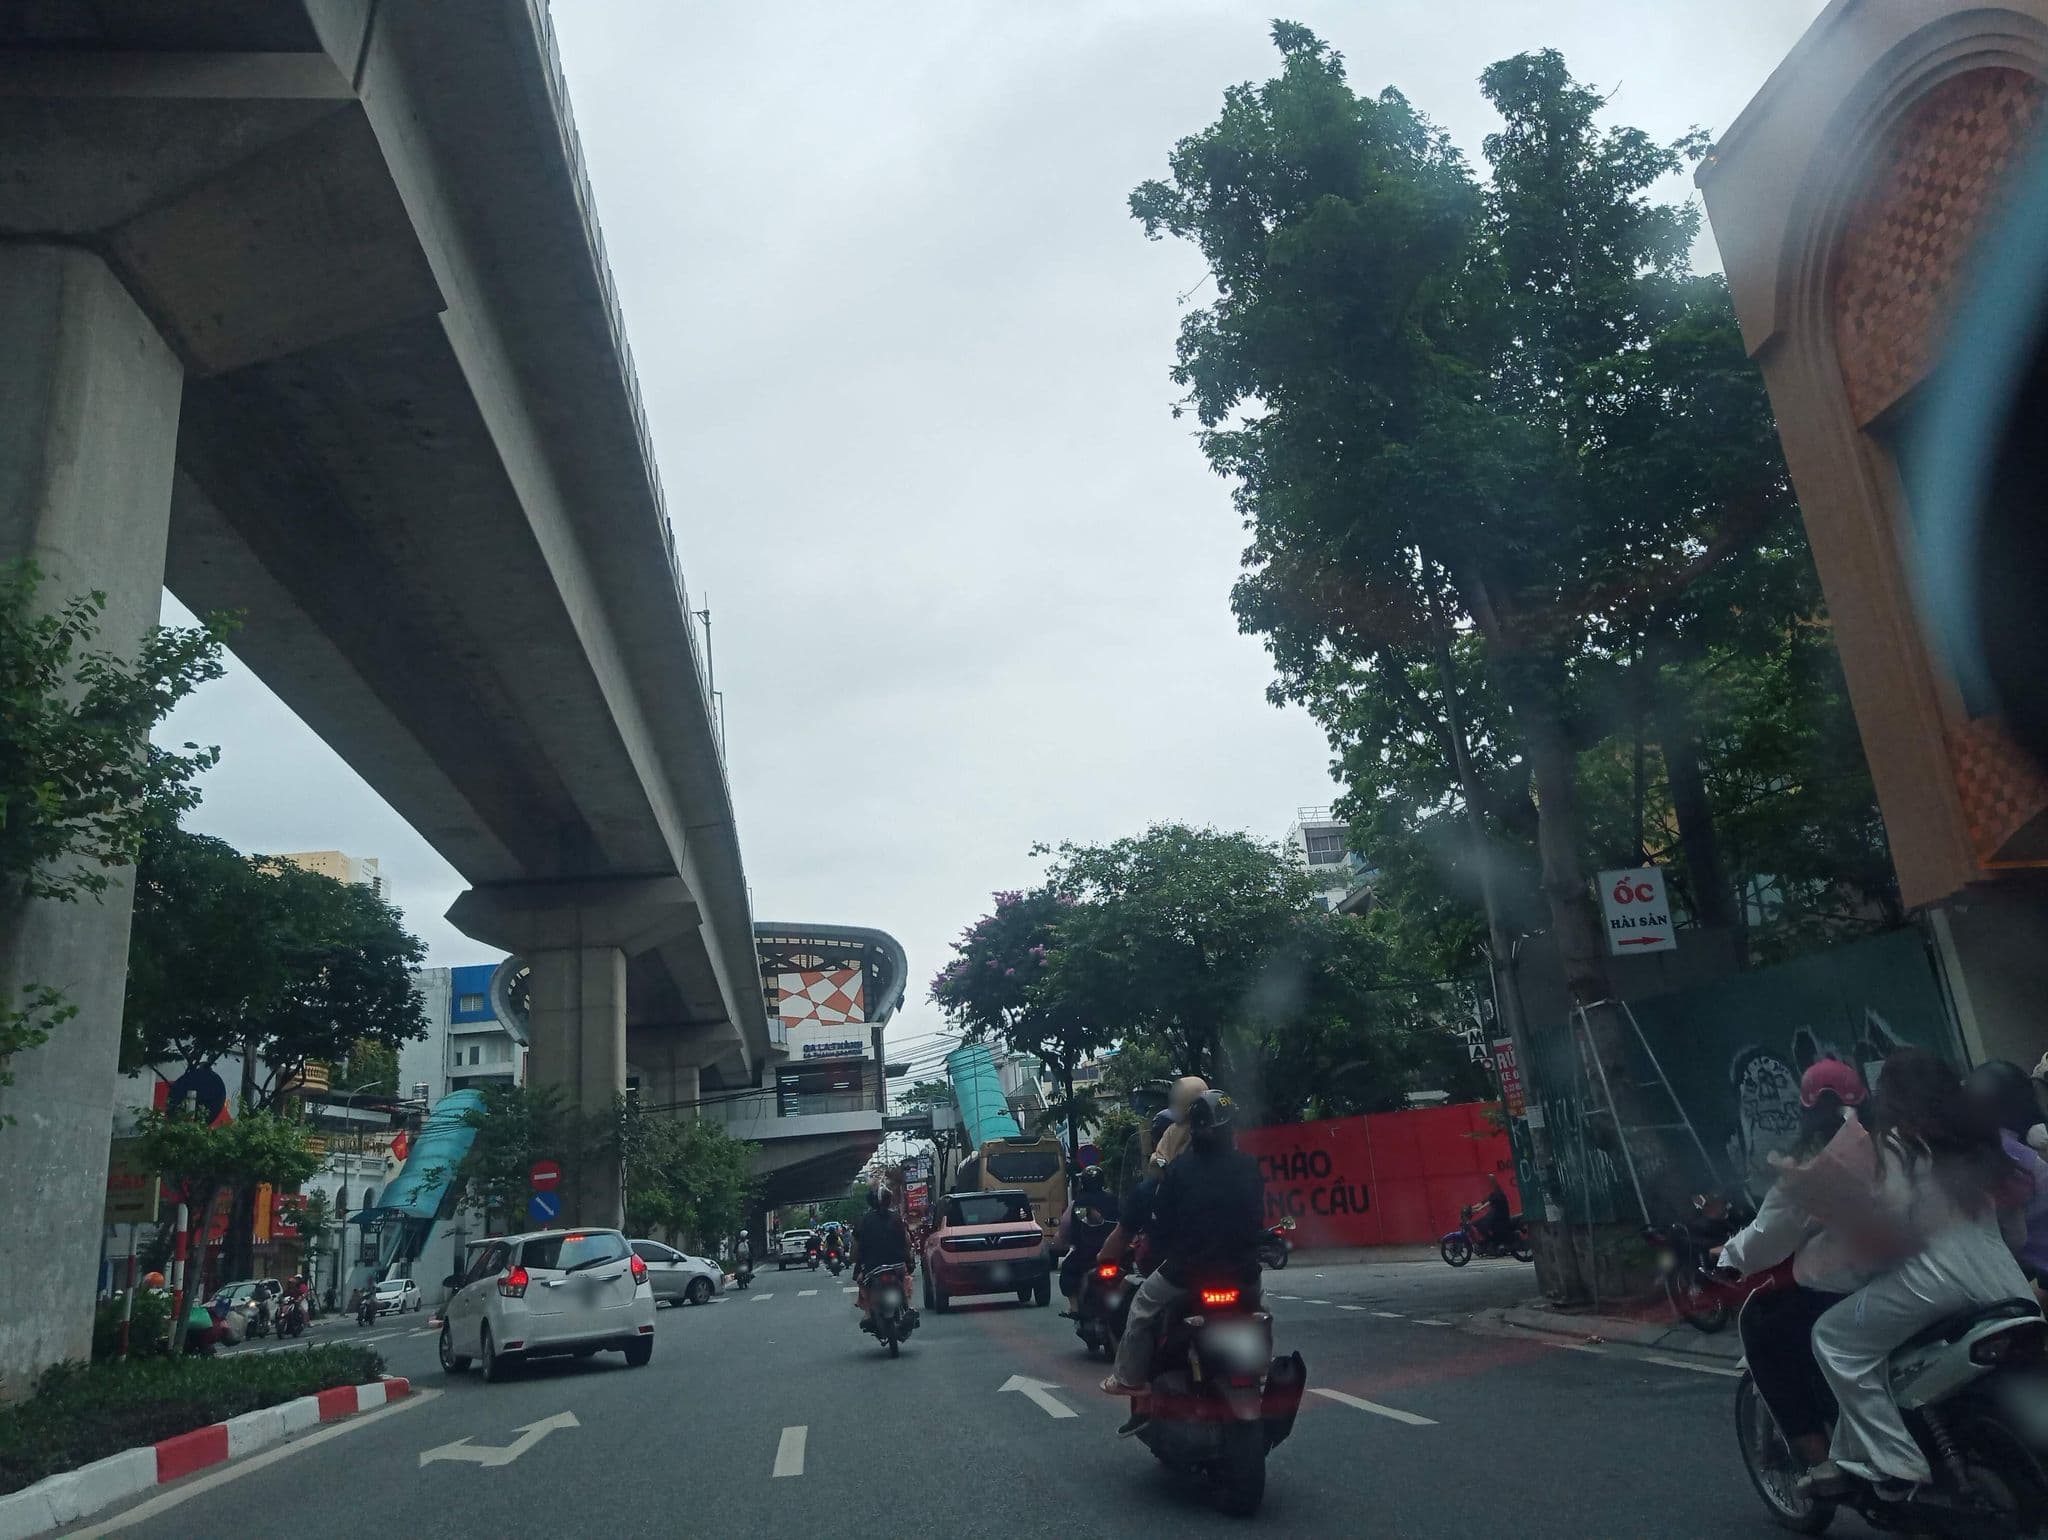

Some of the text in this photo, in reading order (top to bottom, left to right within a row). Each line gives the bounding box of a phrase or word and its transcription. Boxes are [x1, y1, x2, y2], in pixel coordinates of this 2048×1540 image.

[1613, 876, 1655, 905] ỐC
[1610, 912, 1668, 929] HẢI SẢN
